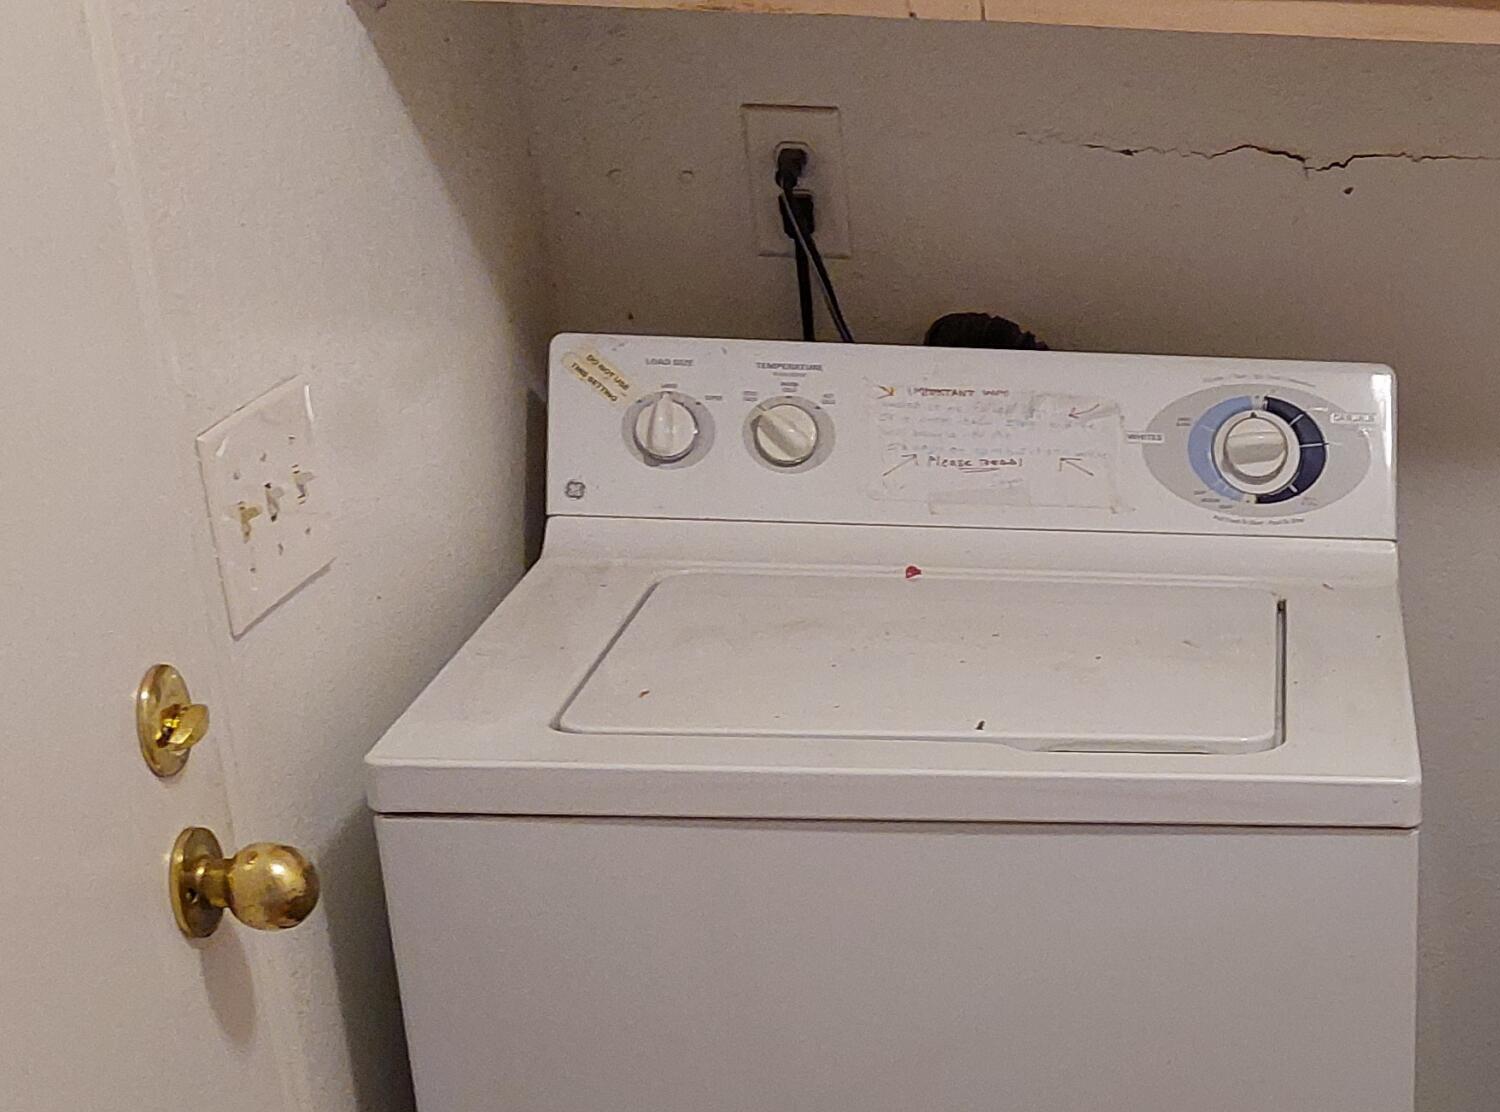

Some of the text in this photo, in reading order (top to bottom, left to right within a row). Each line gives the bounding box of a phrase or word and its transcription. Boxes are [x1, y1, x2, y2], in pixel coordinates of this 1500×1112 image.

[645, 358, 671, 366] LOAD
[755, 362, 823, 371] TEMPERATURE
[598, 364, 615, 377] NOT
[614, 376, 630, 391] USE
